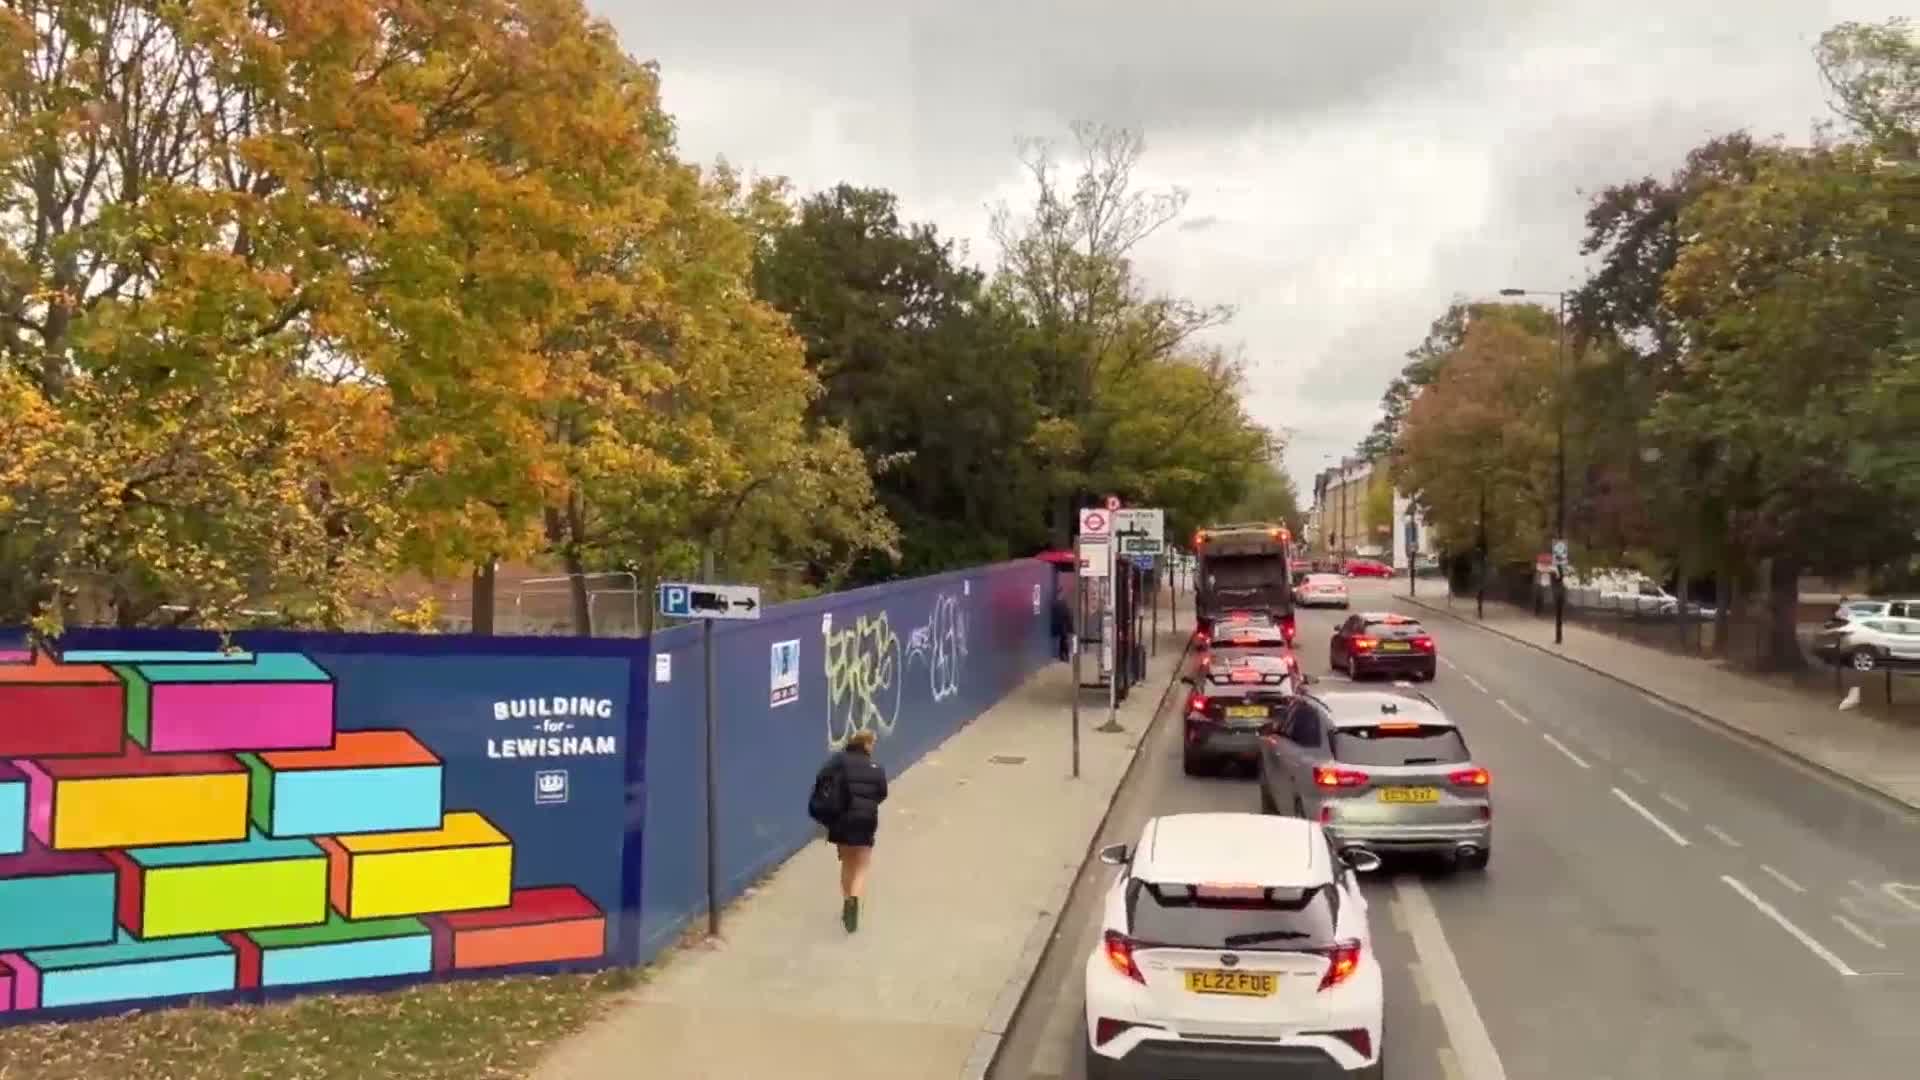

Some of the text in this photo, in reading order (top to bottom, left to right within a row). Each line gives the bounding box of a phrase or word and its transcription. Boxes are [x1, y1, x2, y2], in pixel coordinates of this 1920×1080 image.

[668, 588, 685, 612] P
[493, 697, 613, 720] BUILDING
[487, 736, 616, 758] LEWISHAM
